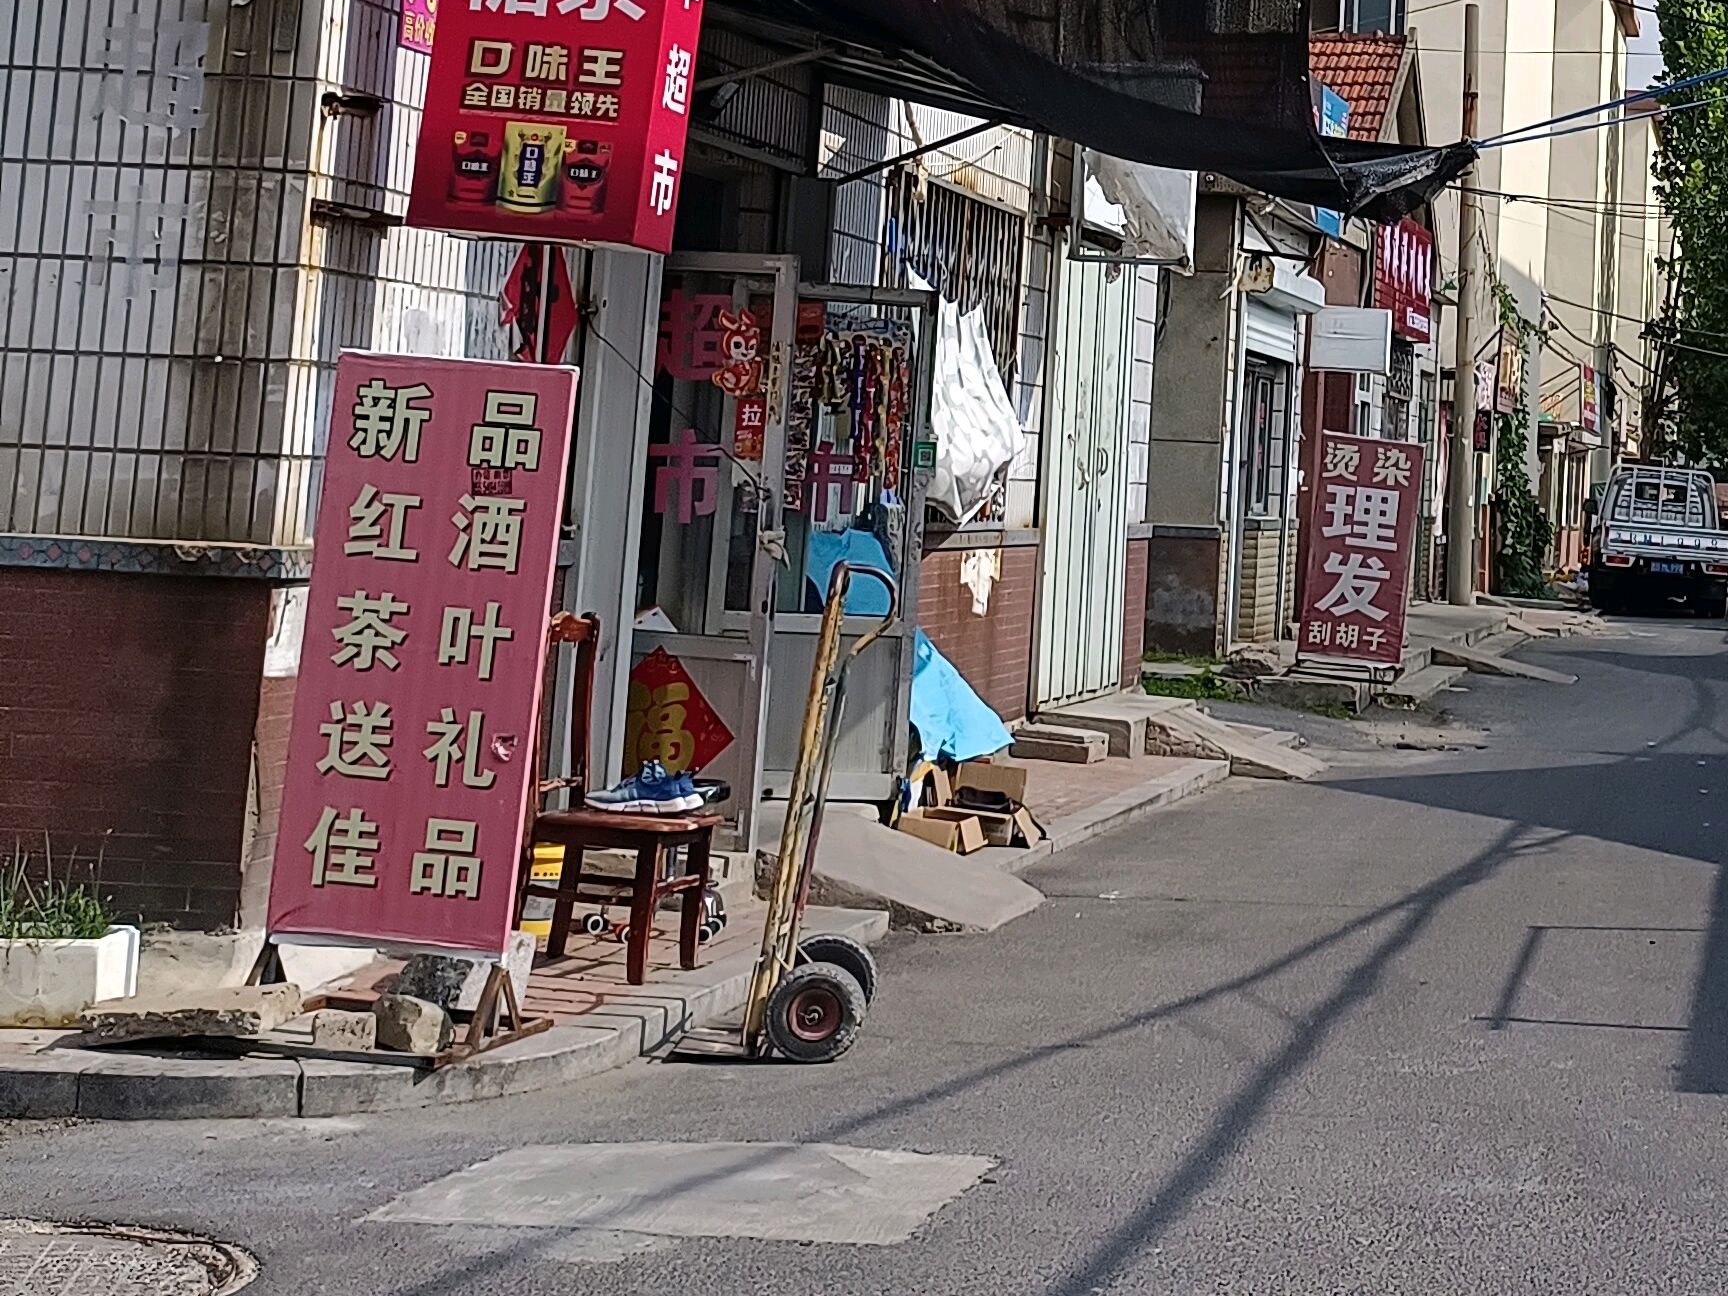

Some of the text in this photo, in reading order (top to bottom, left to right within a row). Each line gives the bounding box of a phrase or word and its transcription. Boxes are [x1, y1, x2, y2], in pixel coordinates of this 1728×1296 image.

[463, 81, 620, 119] 全国销量领先
[469, 39, 624, 87] 口味王
[349, 379, 543, 472] 新品
[742, 404, 762, 426] 拉
[1322, 442, 1412, 487] 烫染
[344, 483, 526, 573] 红酒
[1314, 484, 1400, 622] 理发
[331, 589, 514, 681] 茶叶
[1308, 621, 1387, 651] 刮胡子
[316, 700, 498, 788] 送礼
[304, 806, 482, 899] 佳品
